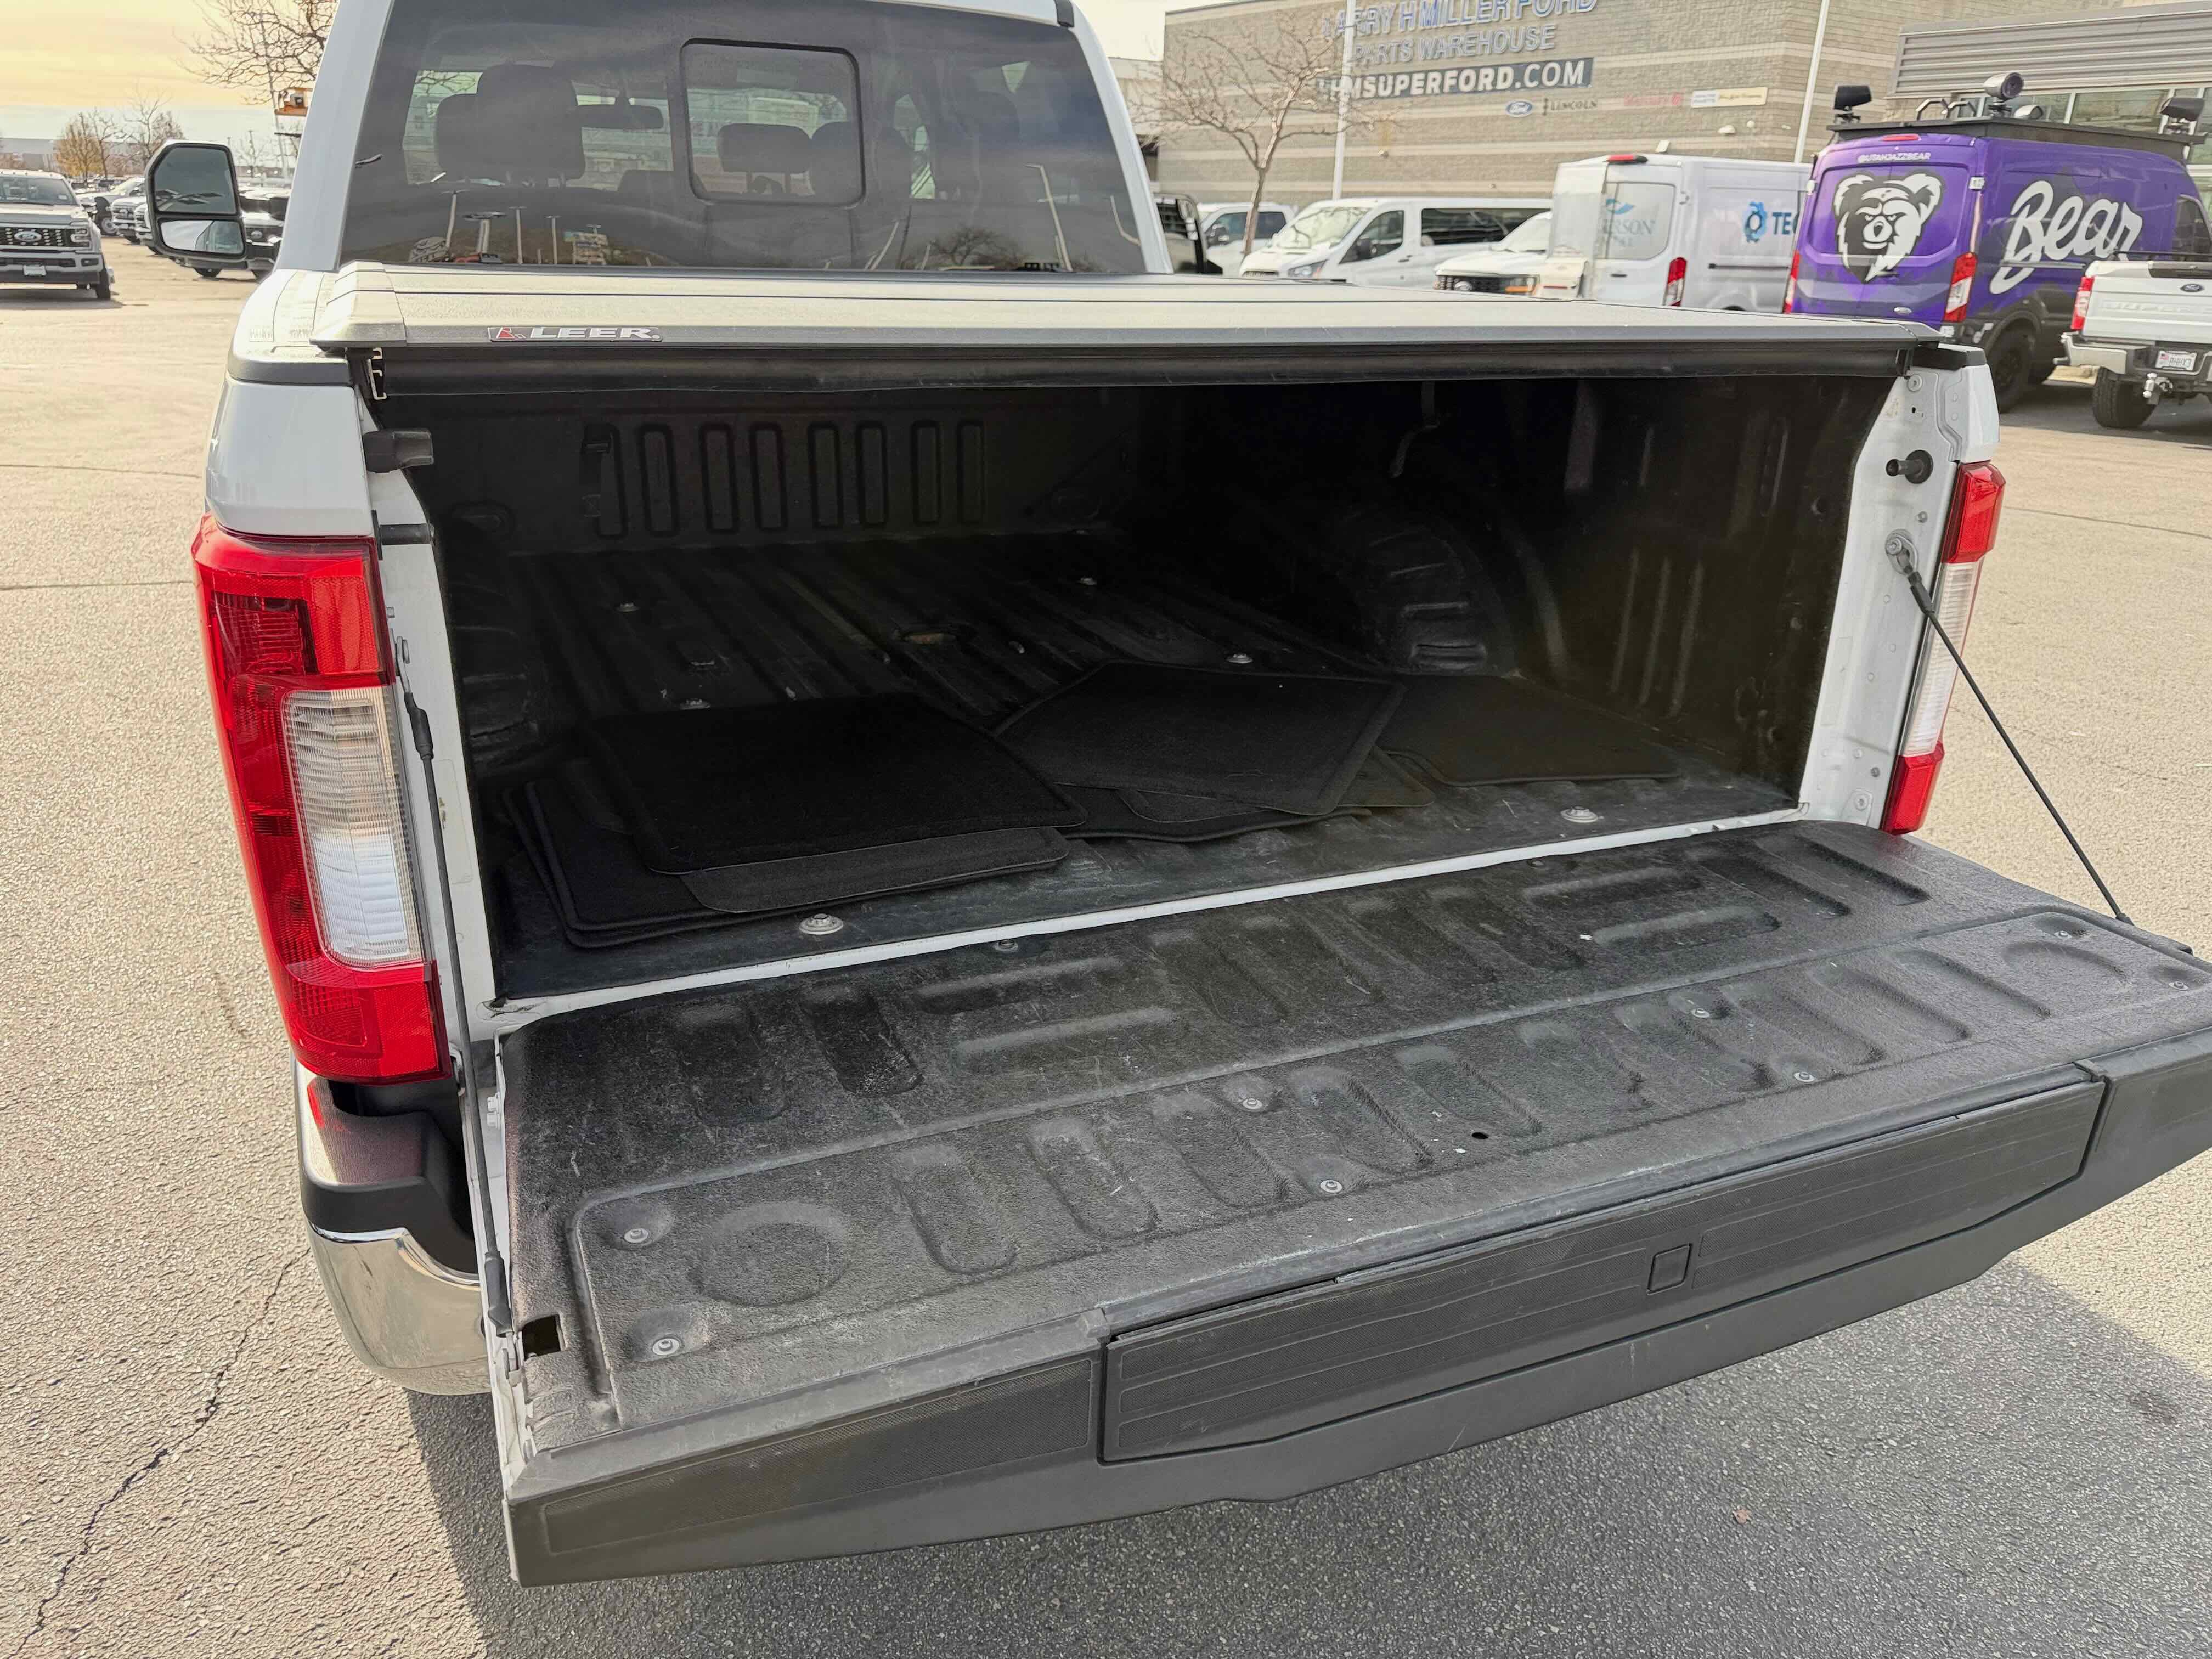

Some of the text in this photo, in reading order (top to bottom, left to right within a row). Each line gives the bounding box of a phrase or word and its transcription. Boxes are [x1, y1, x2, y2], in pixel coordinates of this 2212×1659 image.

[1399, 1, 1417, 32] H
[1419, 0, 1510, 27] MILLER
[1355, 24, 1558, 67] PARTS WAREHOUSE
[1990, 180, 2142, 294] Bear
[530, 328, 652, 339] LEER
